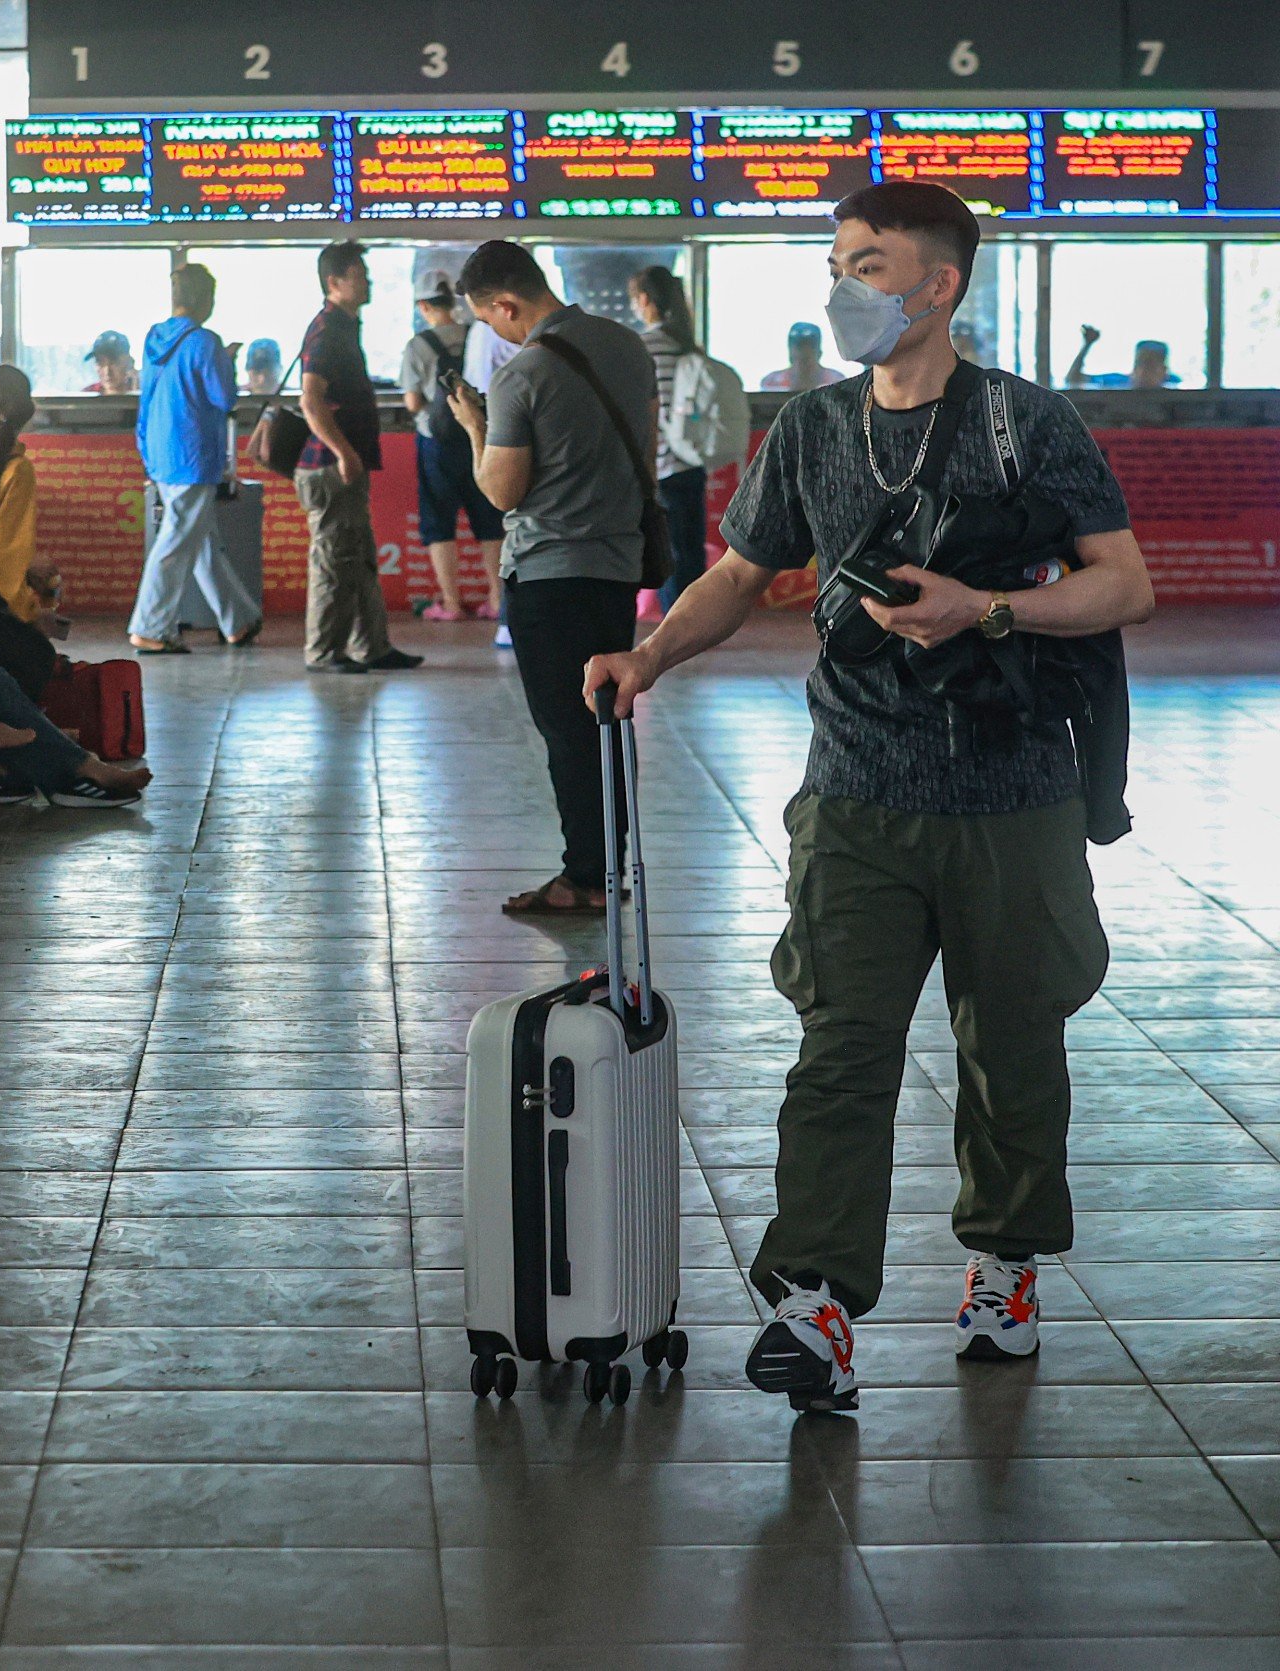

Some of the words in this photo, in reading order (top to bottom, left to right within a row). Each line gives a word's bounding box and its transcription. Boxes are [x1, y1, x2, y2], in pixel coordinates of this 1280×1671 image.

[71, 46, 89, 82] 1
[244, 44, 271, 80] 2
[421, 43, 448, 78] 3
[601, 42, 630, 77] 4
[772, 41, 800, 76] 5
[950, 41, 979, 76] 6
[1138, 41, 1164, 76] 7
[990, 384, 1005, 431] CHRISTIAN
[997, 434, 1012, 460] DIOR
[117, 489, 145, 534] 3
[378, 543, 402, 575] 2
